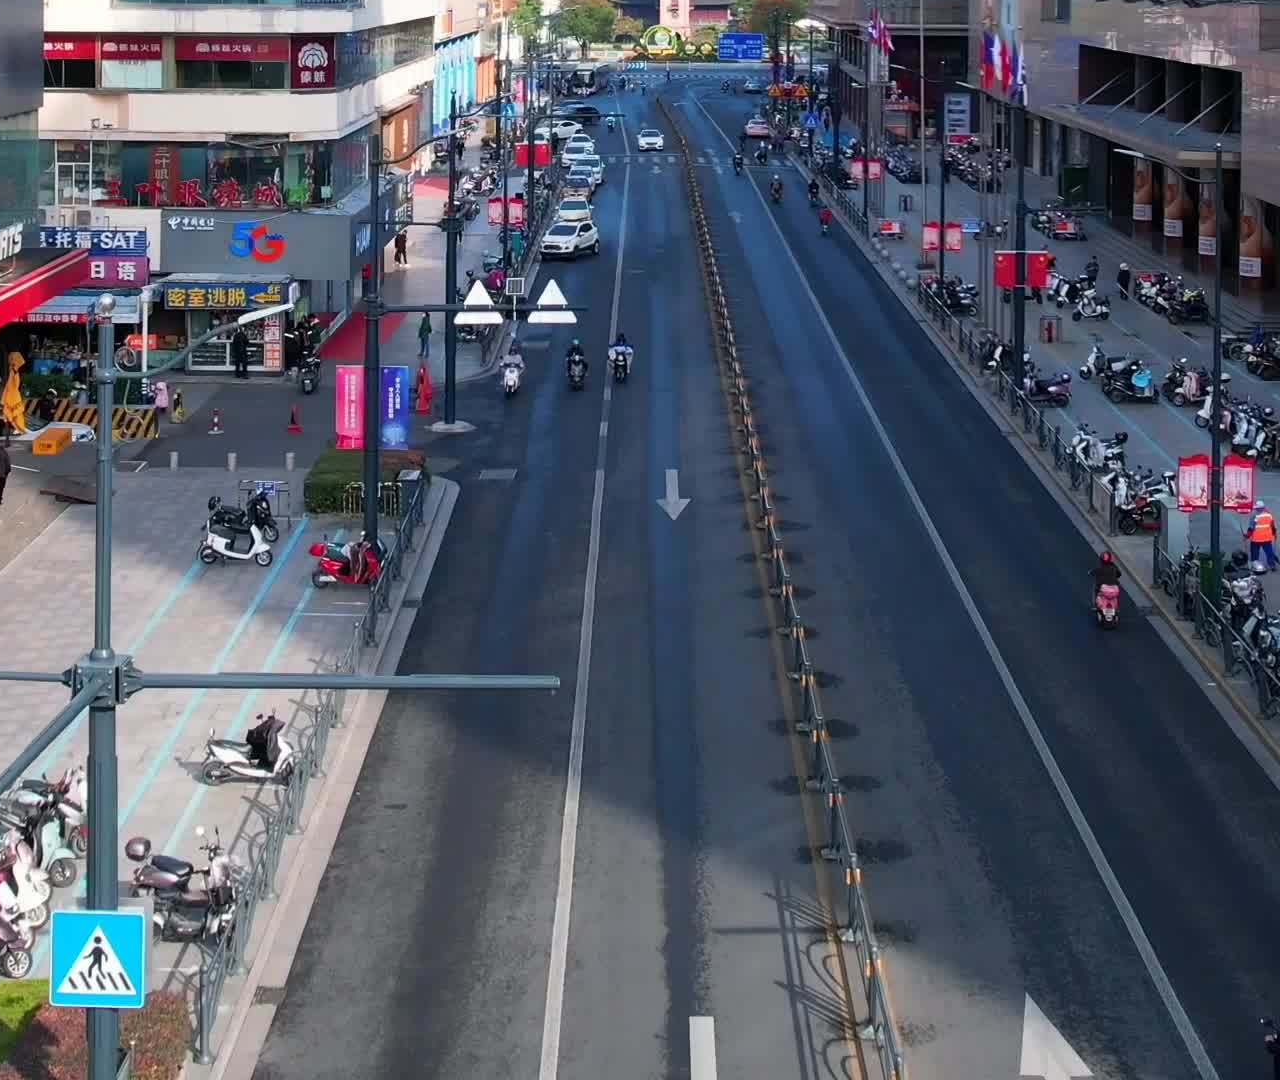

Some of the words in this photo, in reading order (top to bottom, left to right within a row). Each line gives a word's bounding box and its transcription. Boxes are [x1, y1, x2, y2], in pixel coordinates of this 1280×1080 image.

[230, 219, 286, 263] 5G
[90, 261, 137, 281] 日语
[167, 287, 247, 308] 密室逃脱
